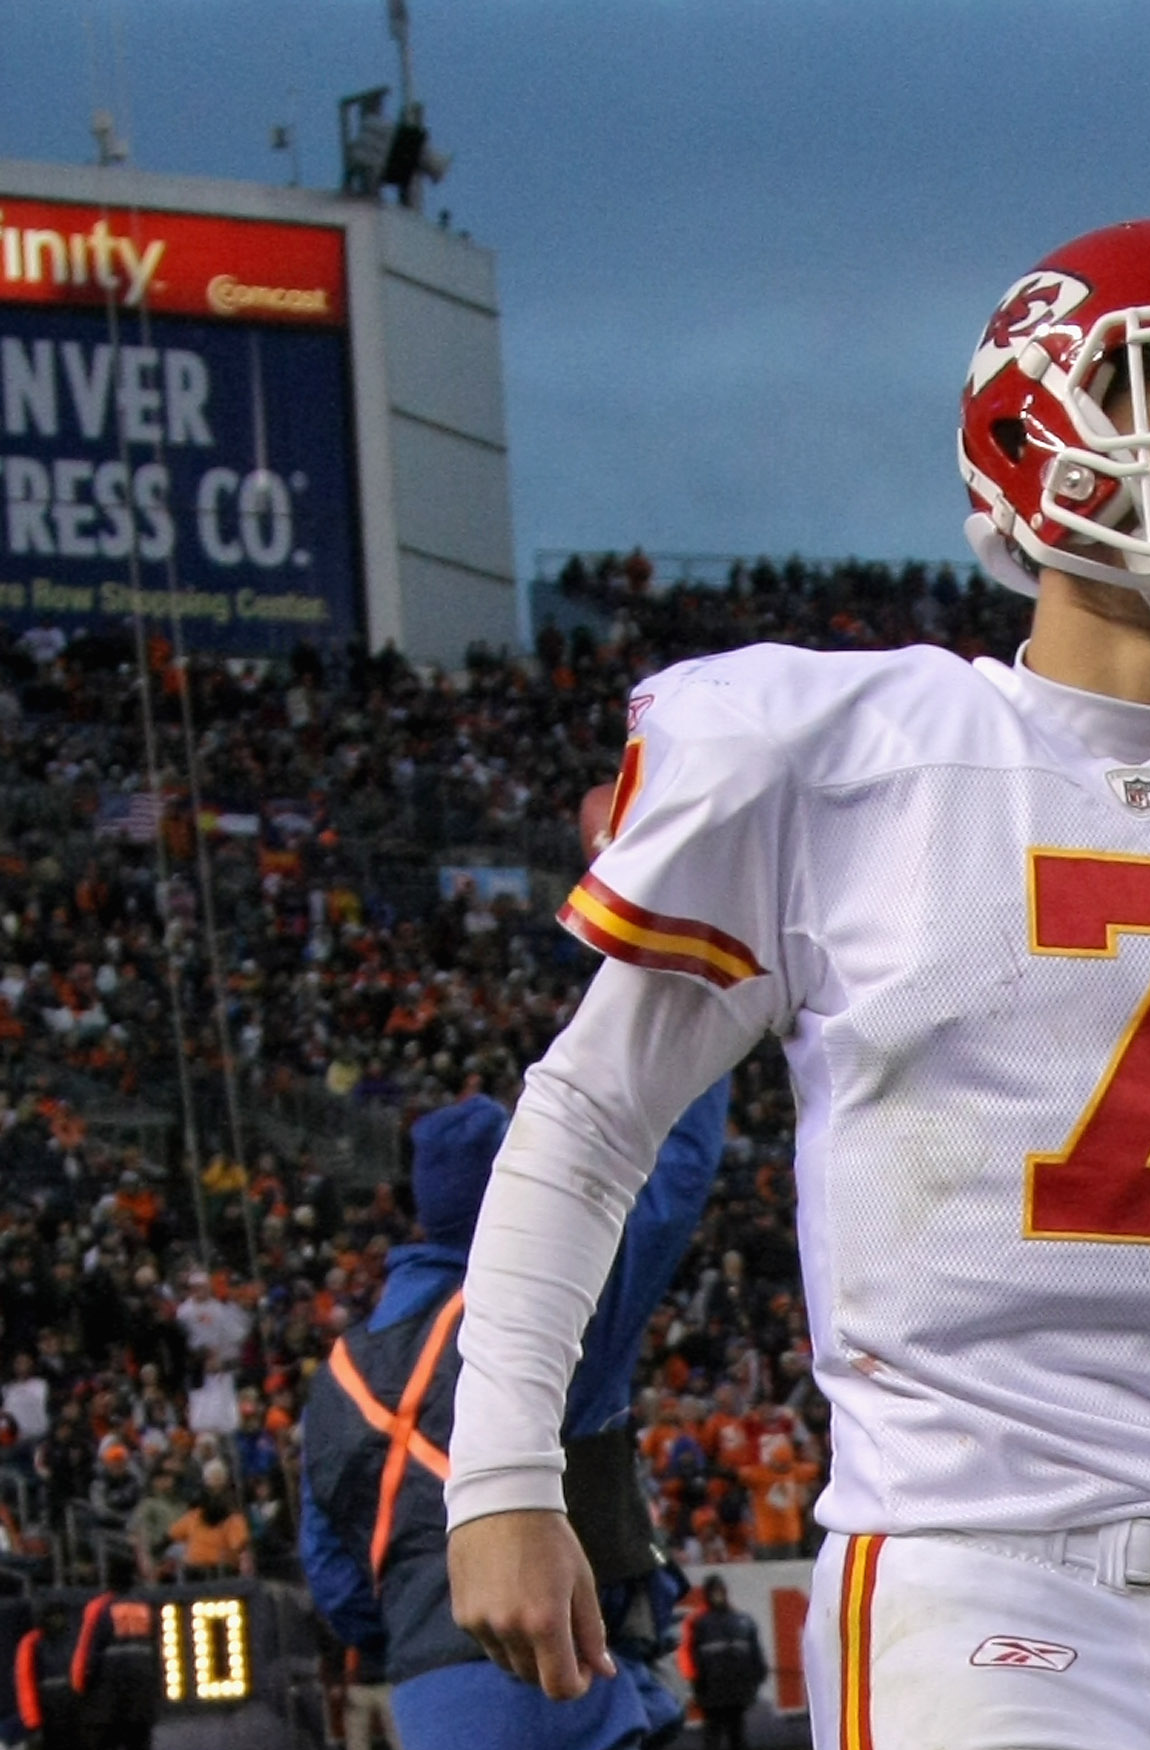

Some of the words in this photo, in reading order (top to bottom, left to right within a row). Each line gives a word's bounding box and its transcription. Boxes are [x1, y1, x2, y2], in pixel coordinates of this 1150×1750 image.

[0, 219, 166, 307] inity
[0, 337, 215, 447] NVER
[101, 581, 229, 625] Shopping
[161, 1600, 246, 1700] 10
